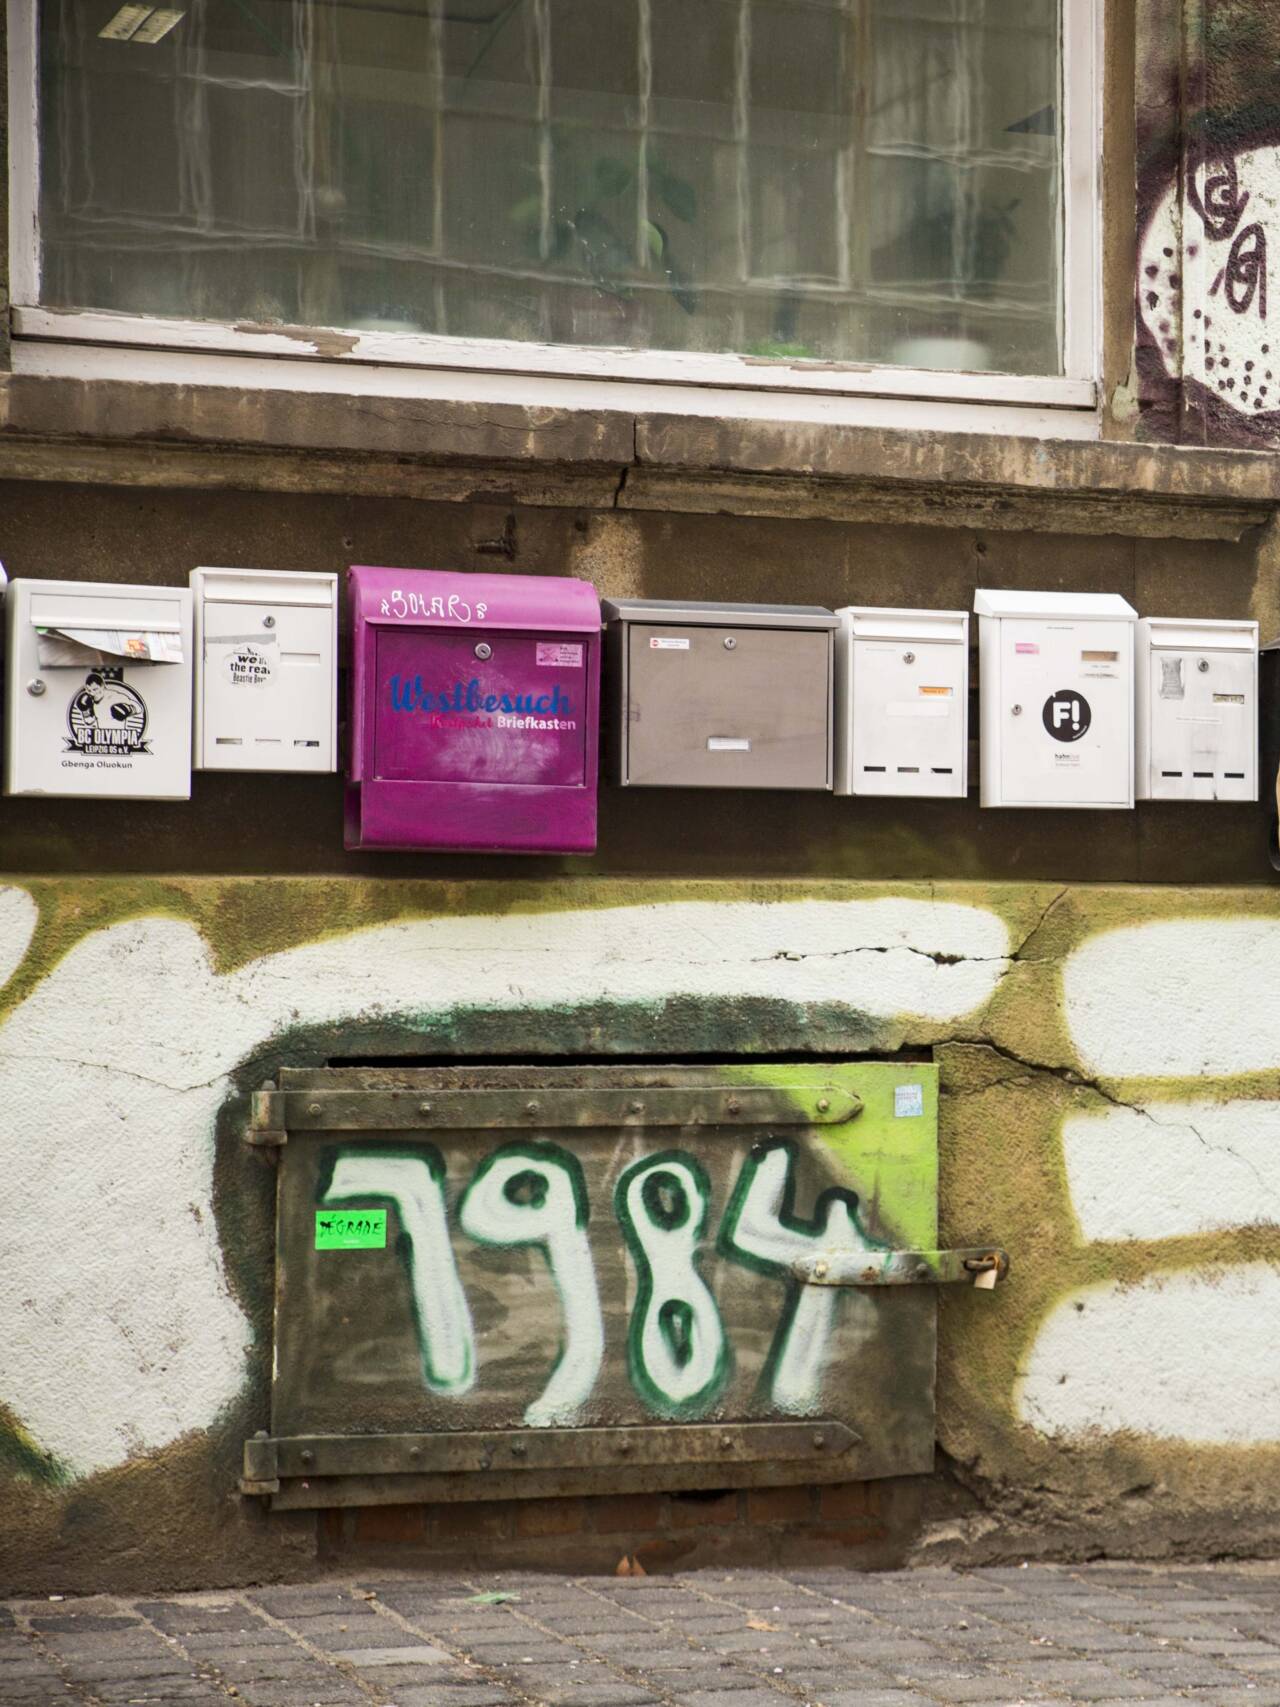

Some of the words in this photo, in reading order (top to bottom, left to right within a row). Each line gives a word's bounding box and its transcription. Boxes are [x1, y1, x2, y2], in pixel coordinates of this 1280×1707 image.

[230, 662, 246, 672] the
[389, 674, 576, 715] Westbesuch
[1053, 700, 1080, 731] F!
[497, 716, 577, 731] Briefkasten
[77, 729, 92, 744] BC
[94, 729, 138, 746] OLYMPIA
[85, 744, 108, 754] LEIPZIG
[61, 760, 95, 769] Gbenga
[96, 760, 133, 769] Oluokun
